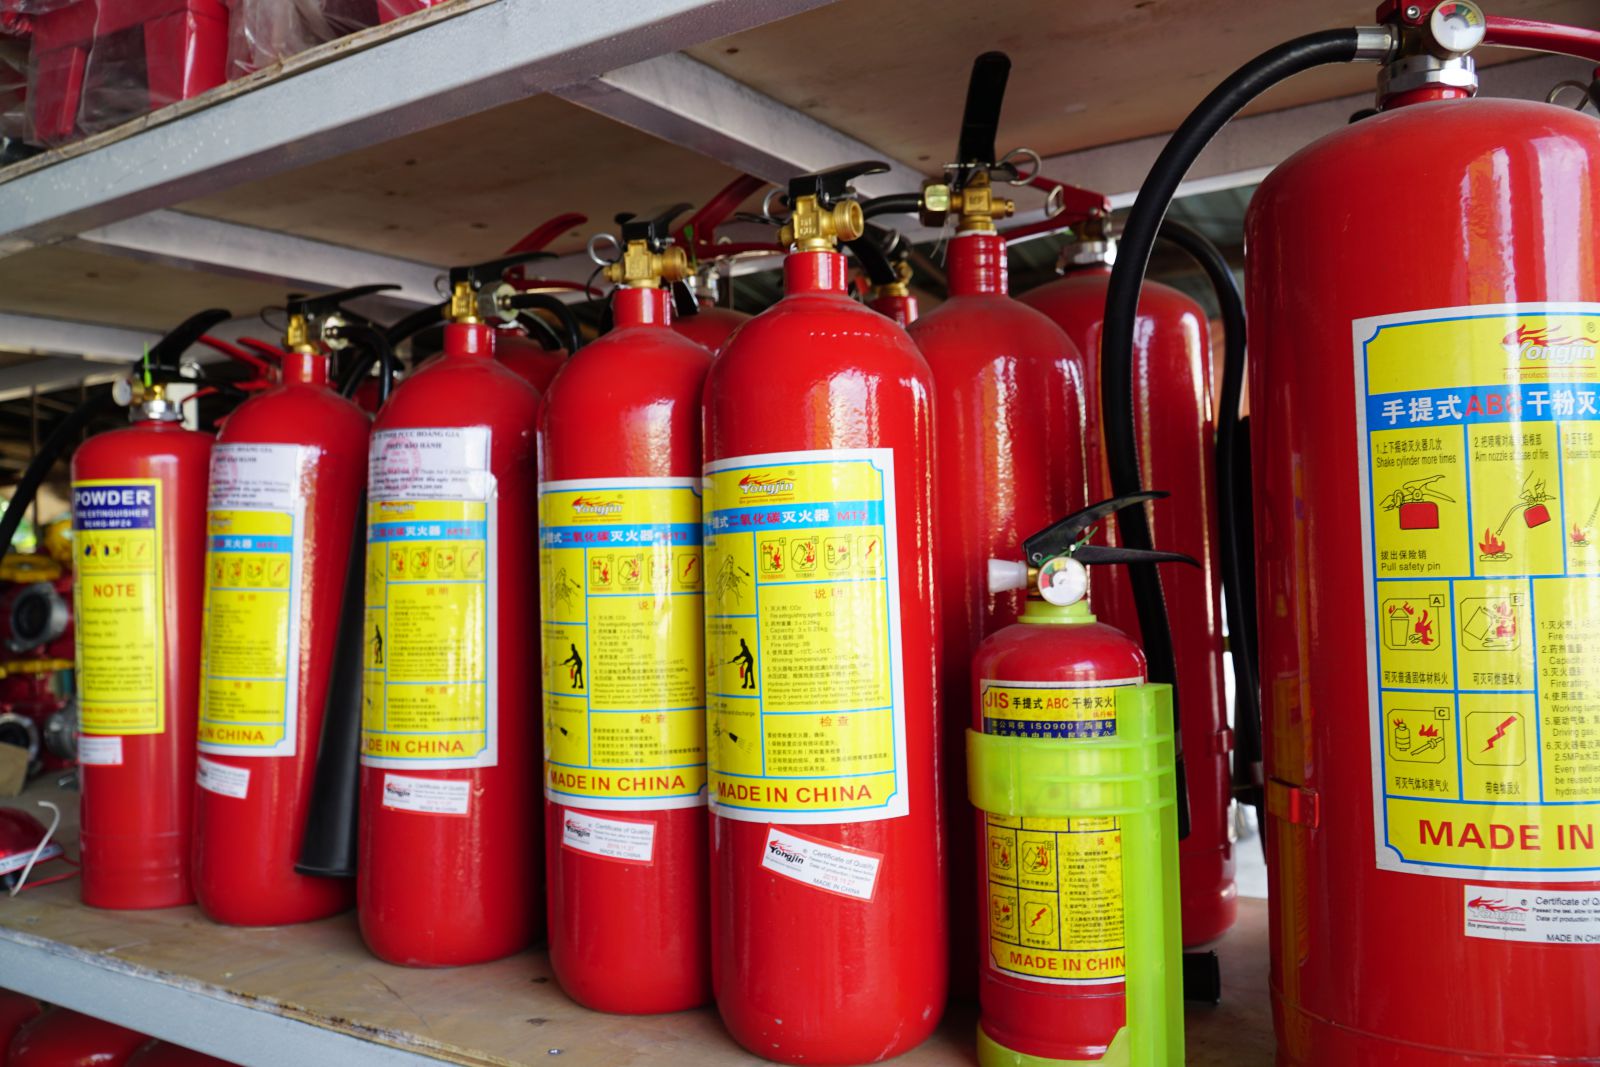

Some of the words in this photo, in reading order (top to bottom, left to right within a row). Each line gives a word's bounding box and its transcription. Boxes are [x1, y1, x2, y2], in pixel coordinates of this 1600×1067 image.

[1376, 456, 1395, 468] Shake
[1397, 455, 1420, 469] cylinder
[1422, 456, 1438, 465] more
[1439, 454, 1456, 464] times
[1475, 451, 1487, 462] Aim
[1489, 451, 1508, 461] nozzle
[740, 479, 794, 495] Yongjin
[74, 489, 152, 506] POWDER
[87, 508, 149, 518] EXTINGUISHER
[573, 504, 622, 515] Yongjin
[1381, 562, 1397, 571] Pull
[1399, 562, 1425, 573] safety
[1427, 562, 1441, 573] pin
[93, 583, 137, 598] NOTE
[1548, 632, 1563, 640] Fire
[985, 692, 1009, 709] JIS
[1013, 697, 1044, 710] 手提式
[1046, 698, 1070, 709] ABC
[1072, 695, 1113, 709] 干粉灭火
[1551, 704, 1582, 714] Working
[1030, 721, 1080, 731] ISO9001
[216, 727, 265, 742] CHINA
[1553, 728, 1579, 738] Driving
[385, 740, 400, 753] IN
[405, 739, 465, 753] CHINA
[1554, 765, 1576, 774] Every
[550, 770, 587, 790] MADE
[591, 777, 610, 791] IN
[617, 775, 686, 791] CHINA
[1555, 776, 1564, 785] be
[717, 781, 761, 802] MADE
[766, 786, 788, 803] IN
[796, 784, 873, 804] CHINA
[1555, 787, 1590, 798] hydraulic
[1419, 819, 1541, 851] MADE
[1557, 823, 1594, 851] IN
[769, 846, 804, 865] Yongjin
[812, 848, 845, 864] Certificate
[1535, 896, 1580, 906] Certificate
[1581, 896, 1590, 906] of
[1560, 916, 1589, 924] production
[1546, 934, 1572, 942] MADE
[1009, 952, 1057, 970] MADE
[1063, 959, 1081, 971] IN
